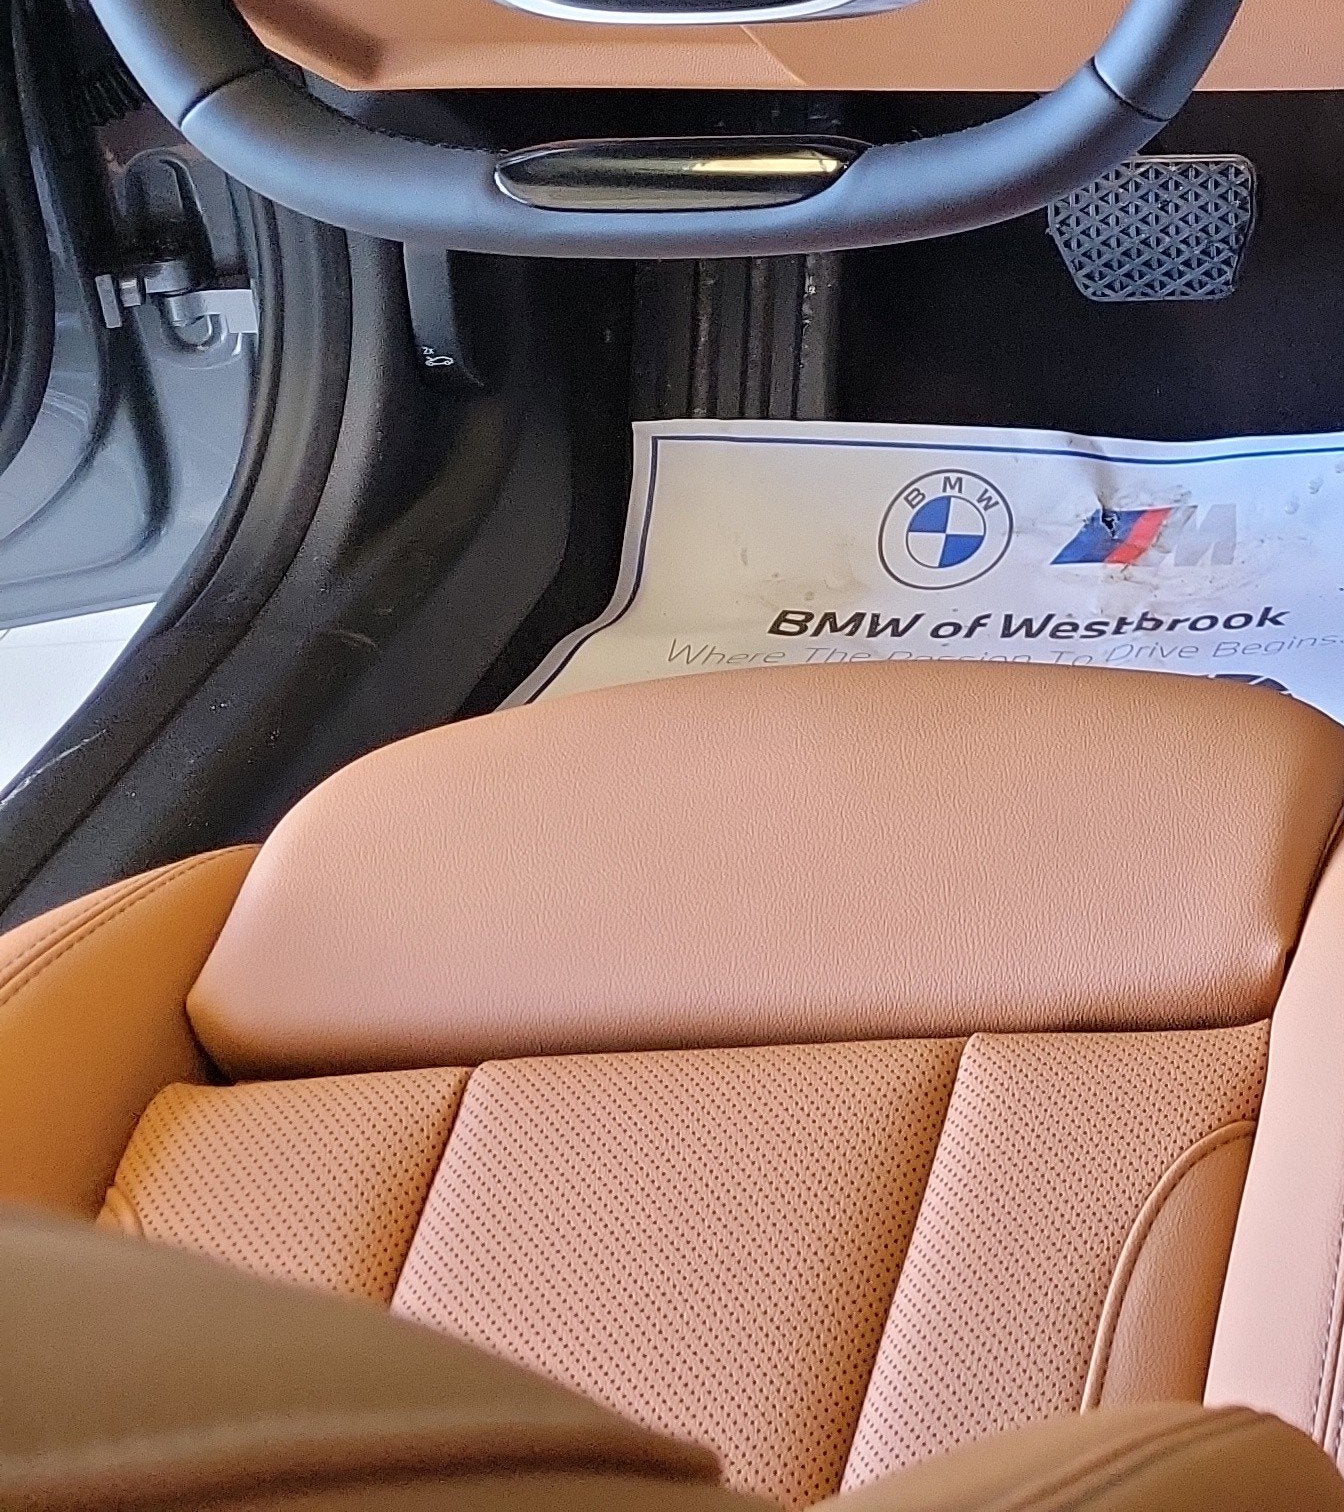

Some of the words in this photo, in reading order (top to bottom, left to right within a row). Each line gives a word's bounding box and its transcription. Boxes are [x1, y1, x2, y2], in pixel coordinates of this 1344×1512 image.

[903, 476, 1000, 512] BMW
[767, 609, 926, 638] BMW
[929, 612, 992, 638] of
[1000, 606, 1290, 639] Westbrook
[667, 638, 786, 666] Where
[804, 647, 871, 663] The
[1051, 650, 1093, 666] To
[1105, 643, 1199, 663] Drive
[1212, 634, 1344, 659] Begins.
